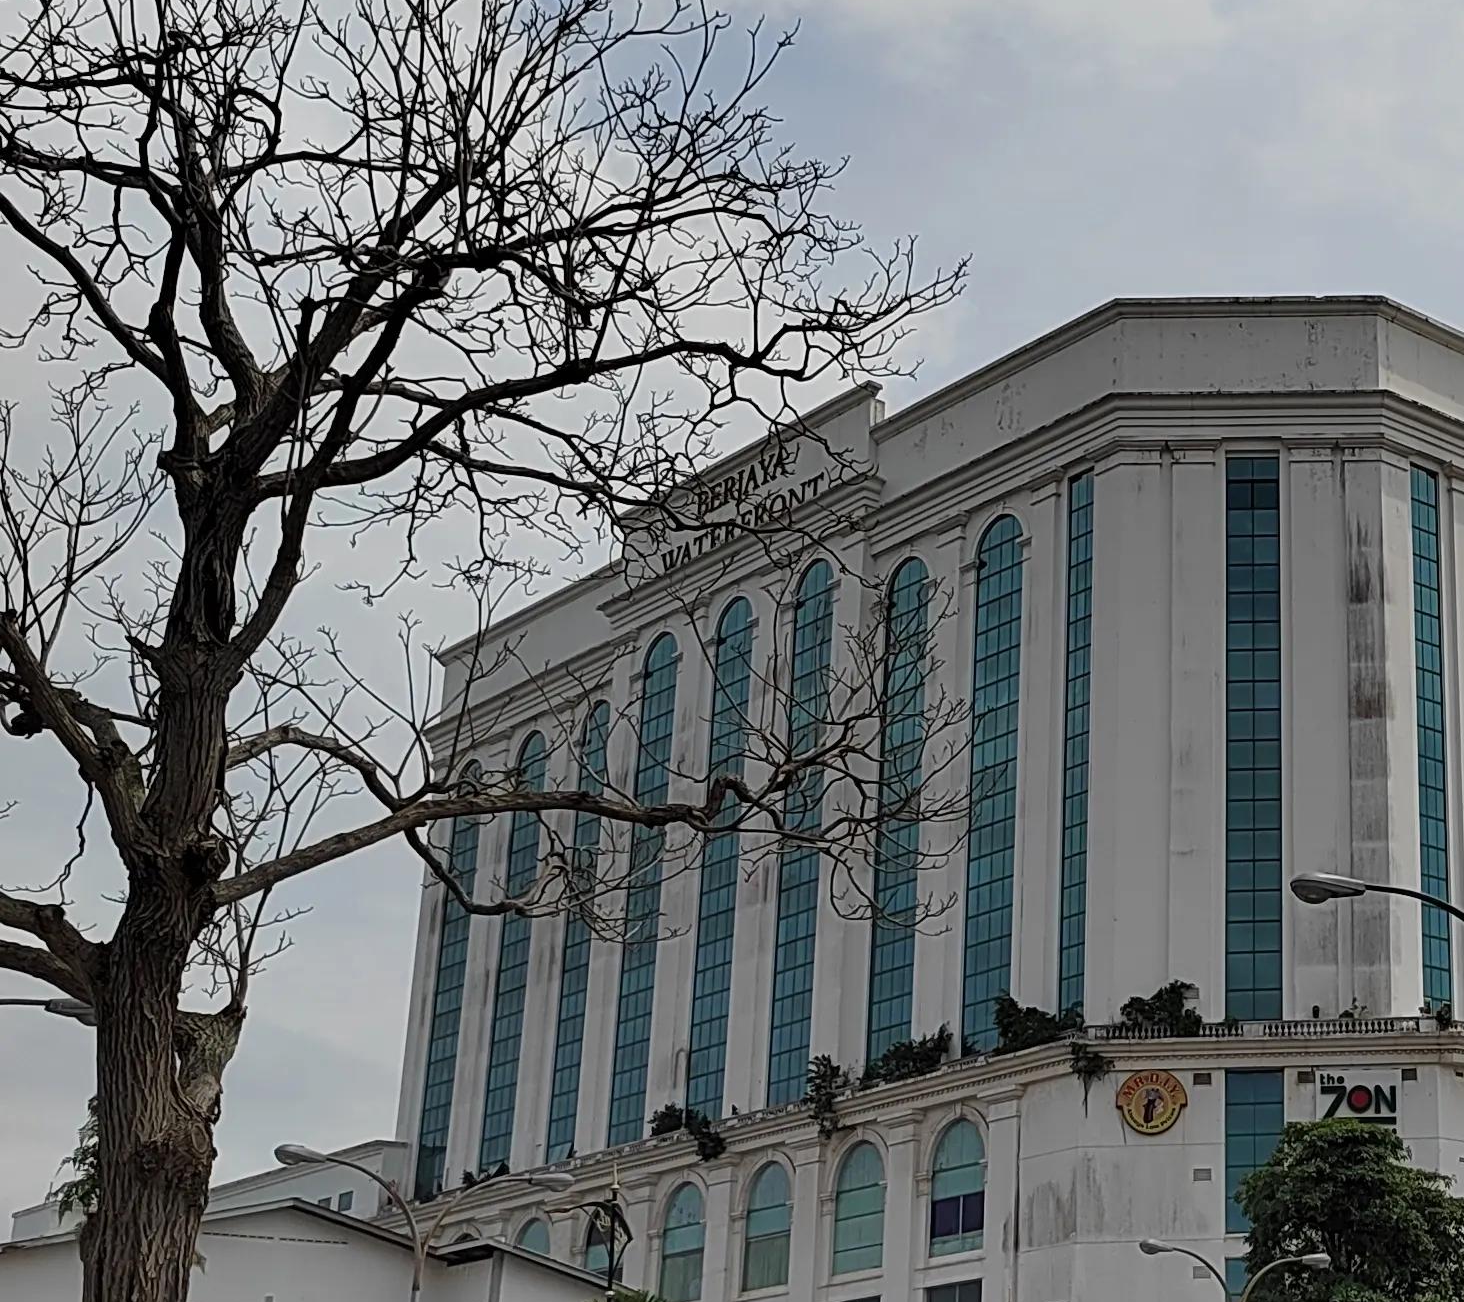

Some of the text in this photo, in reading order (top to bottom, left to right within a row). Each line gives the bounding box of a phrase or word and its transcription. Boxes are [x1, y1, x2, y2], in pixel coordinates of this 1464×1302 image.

[698, 452, 790, 518] BERJAYA
[1319, 1073, 1345, 1085] the
[1320, 1084, 1397, 1123] ZON
